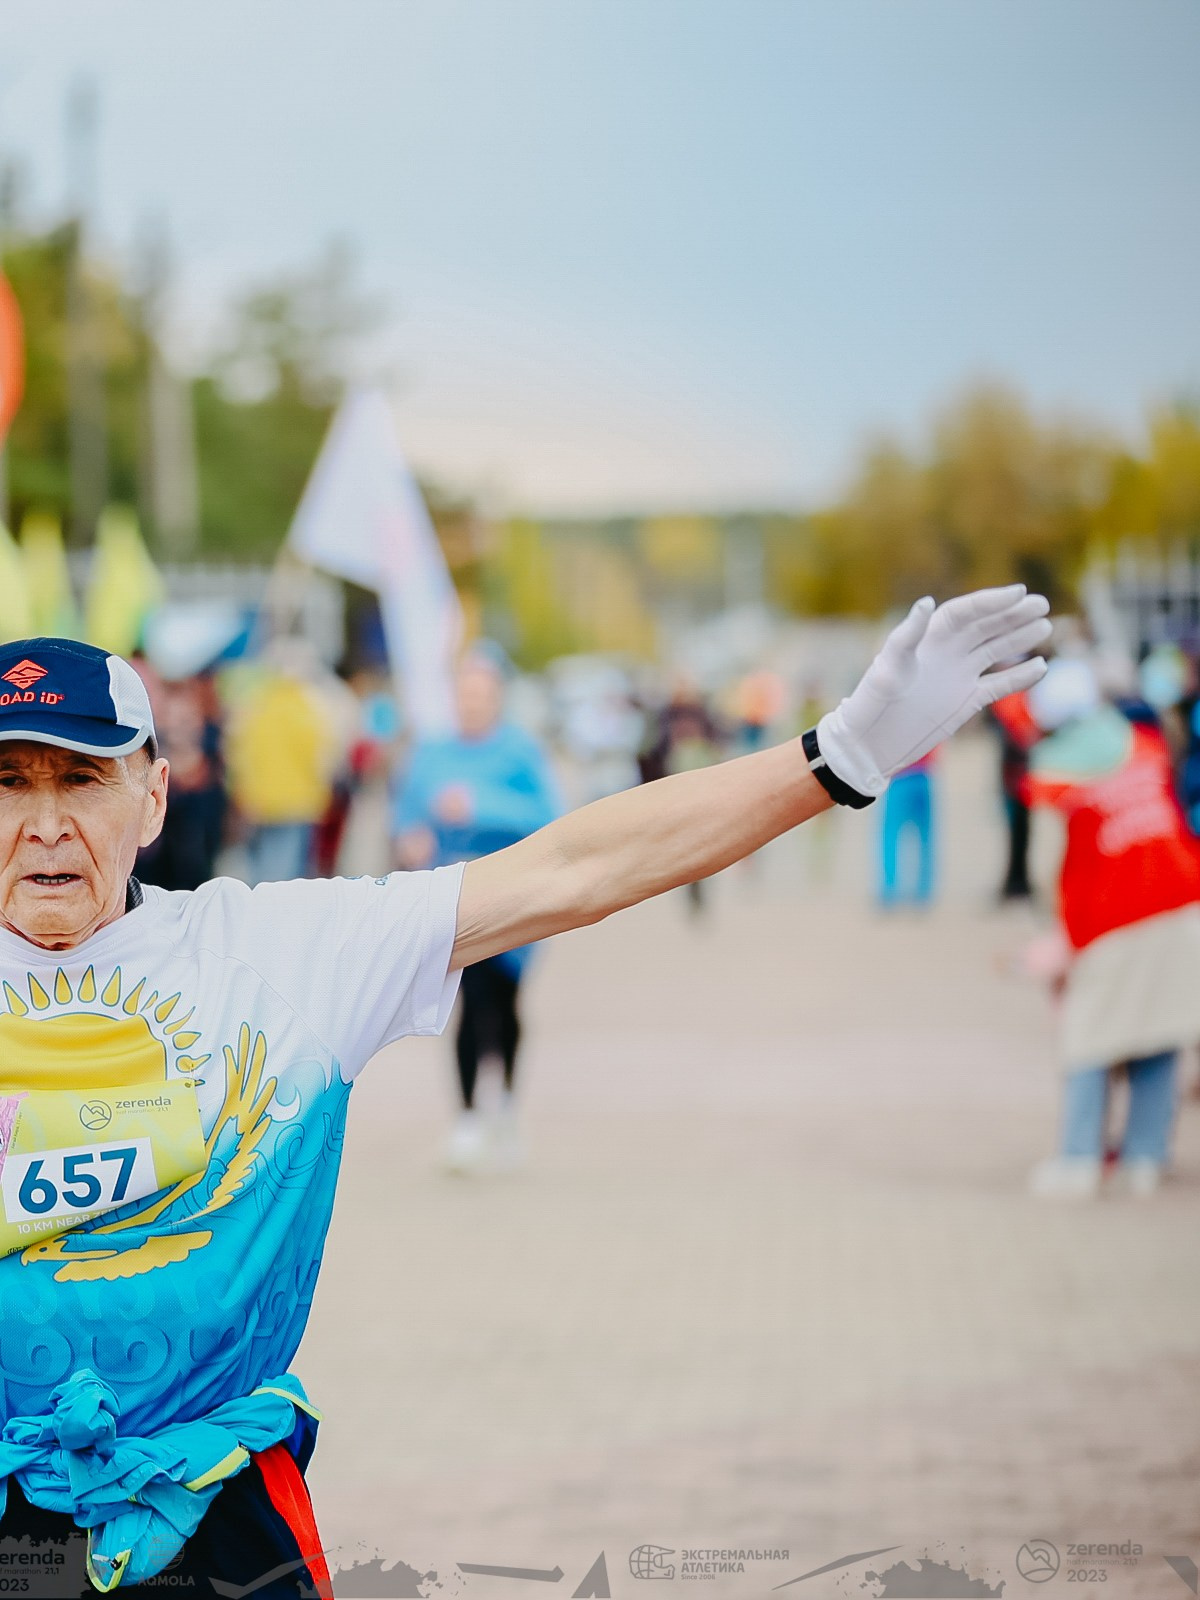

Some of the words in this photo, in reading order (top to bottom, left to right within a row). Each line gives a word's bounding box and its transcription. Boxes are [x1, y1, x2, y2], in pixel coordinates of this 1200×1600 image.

[115, 1096, 171, 1109] zerenda
[18, 1147, 138, 1214] 657
[17, 1223, 31, 1234] 10
[33, 1221, 53, 1232] KM
[56, 1214, 91, 1228] NEAR
